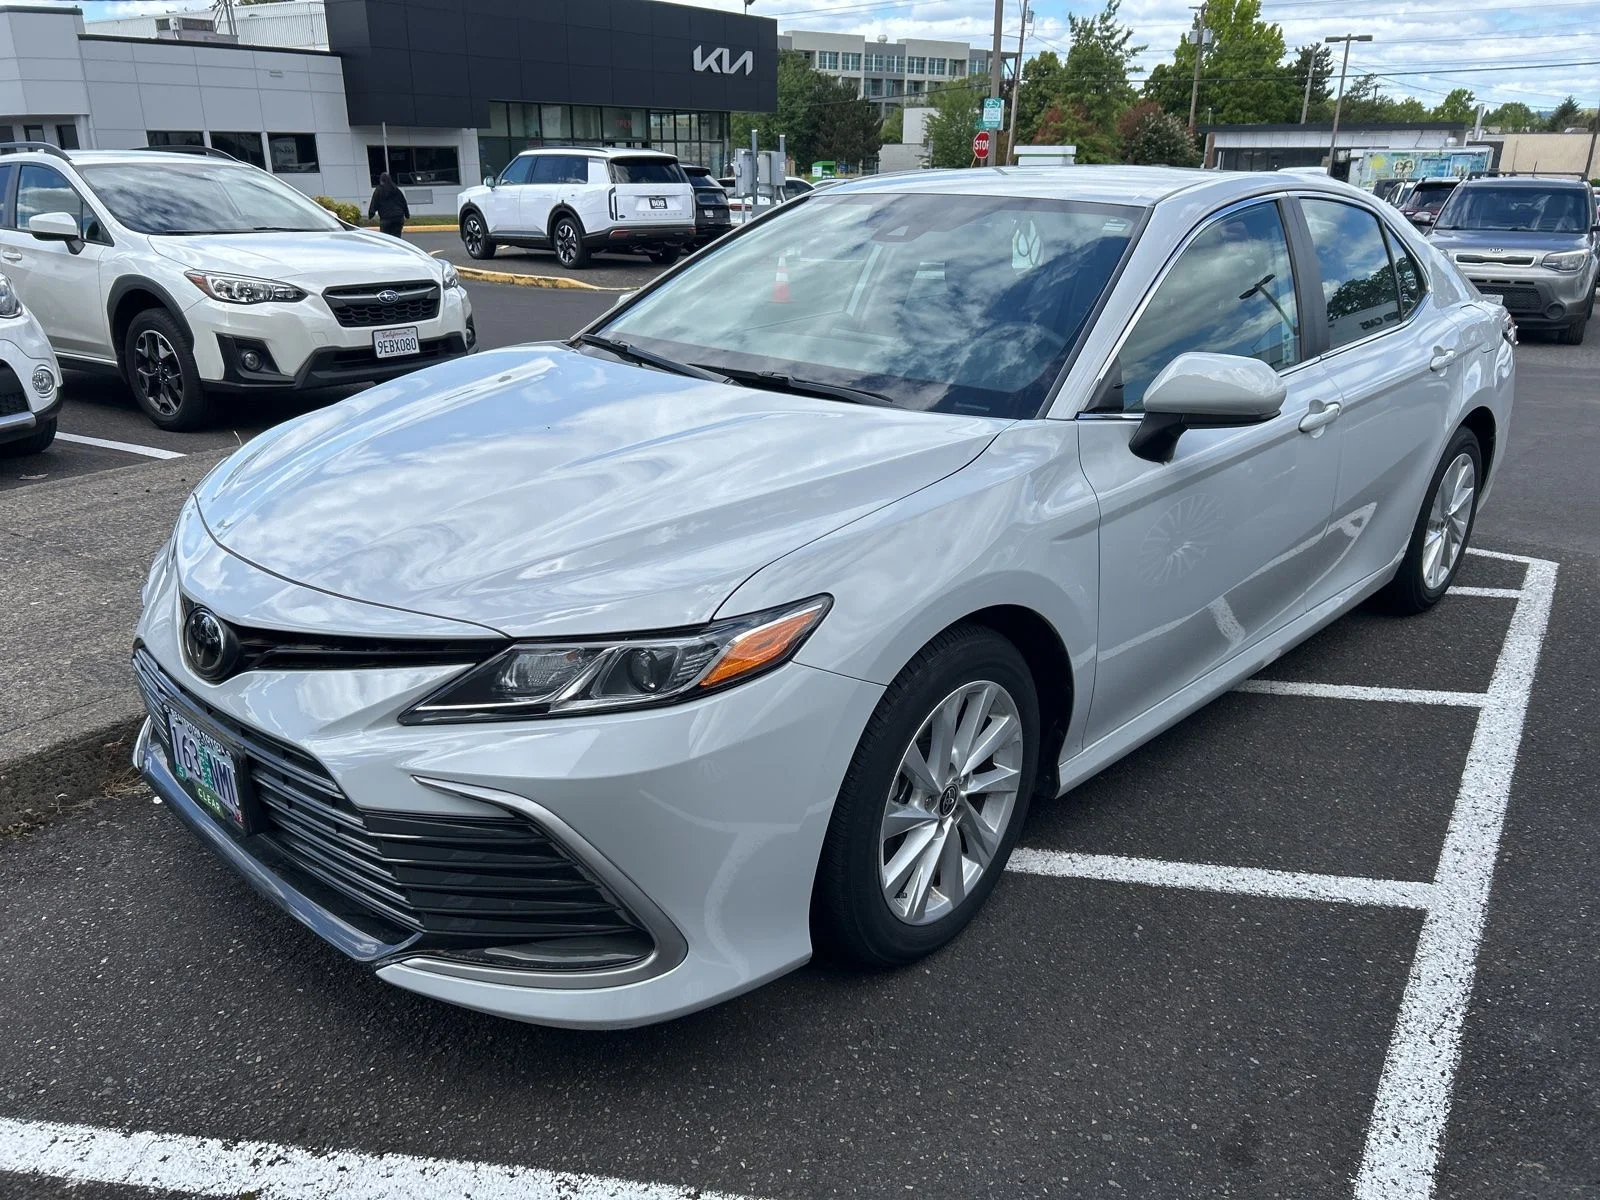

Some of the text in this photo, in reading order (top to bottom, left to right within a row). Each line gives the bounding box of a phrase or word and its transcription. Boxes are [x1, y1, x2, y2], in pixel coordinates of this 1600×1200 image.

[693, 45, 753, 76] KIA
[651, 199, 666, 207] BOB
[377, 337, 417, 355] 9EBX080
[172, 724, 202, 780] 163
[197, 788, 221, 813] CLEAR
